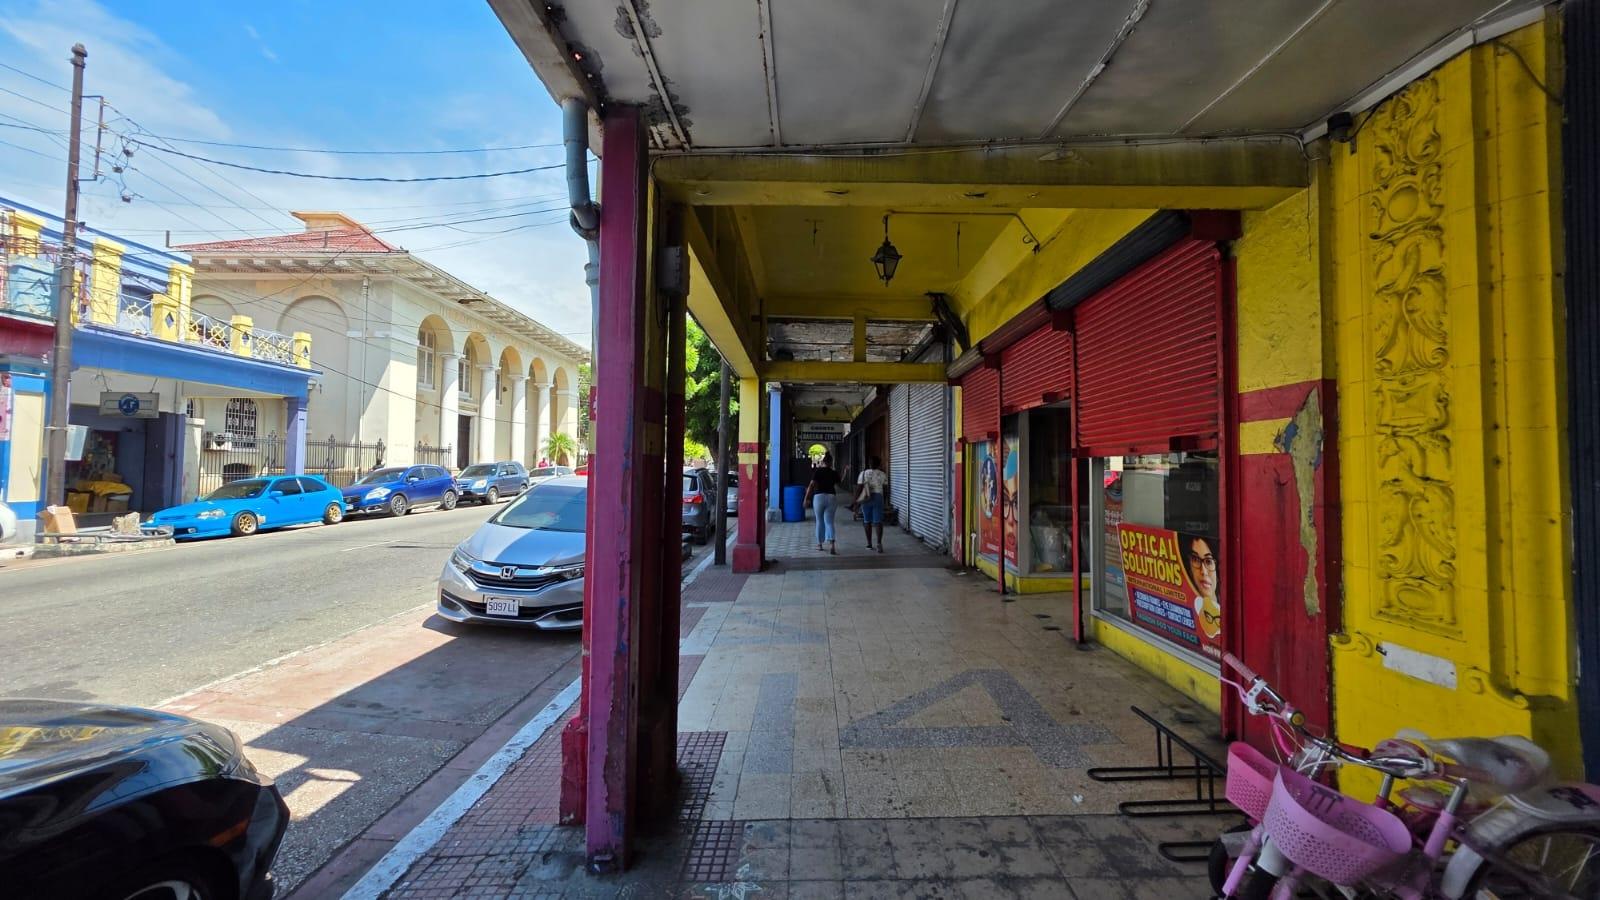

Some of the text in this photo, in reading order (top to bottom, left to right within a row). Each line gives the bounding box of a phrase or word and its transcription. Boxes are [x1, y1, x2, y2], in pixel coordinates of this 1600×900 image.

[1121, 530, 1177, 561] OPTICAL
[1123, 551, 1182, 586] SOLUTIONS
[1163, 588, 1185, 601] LIMITED
